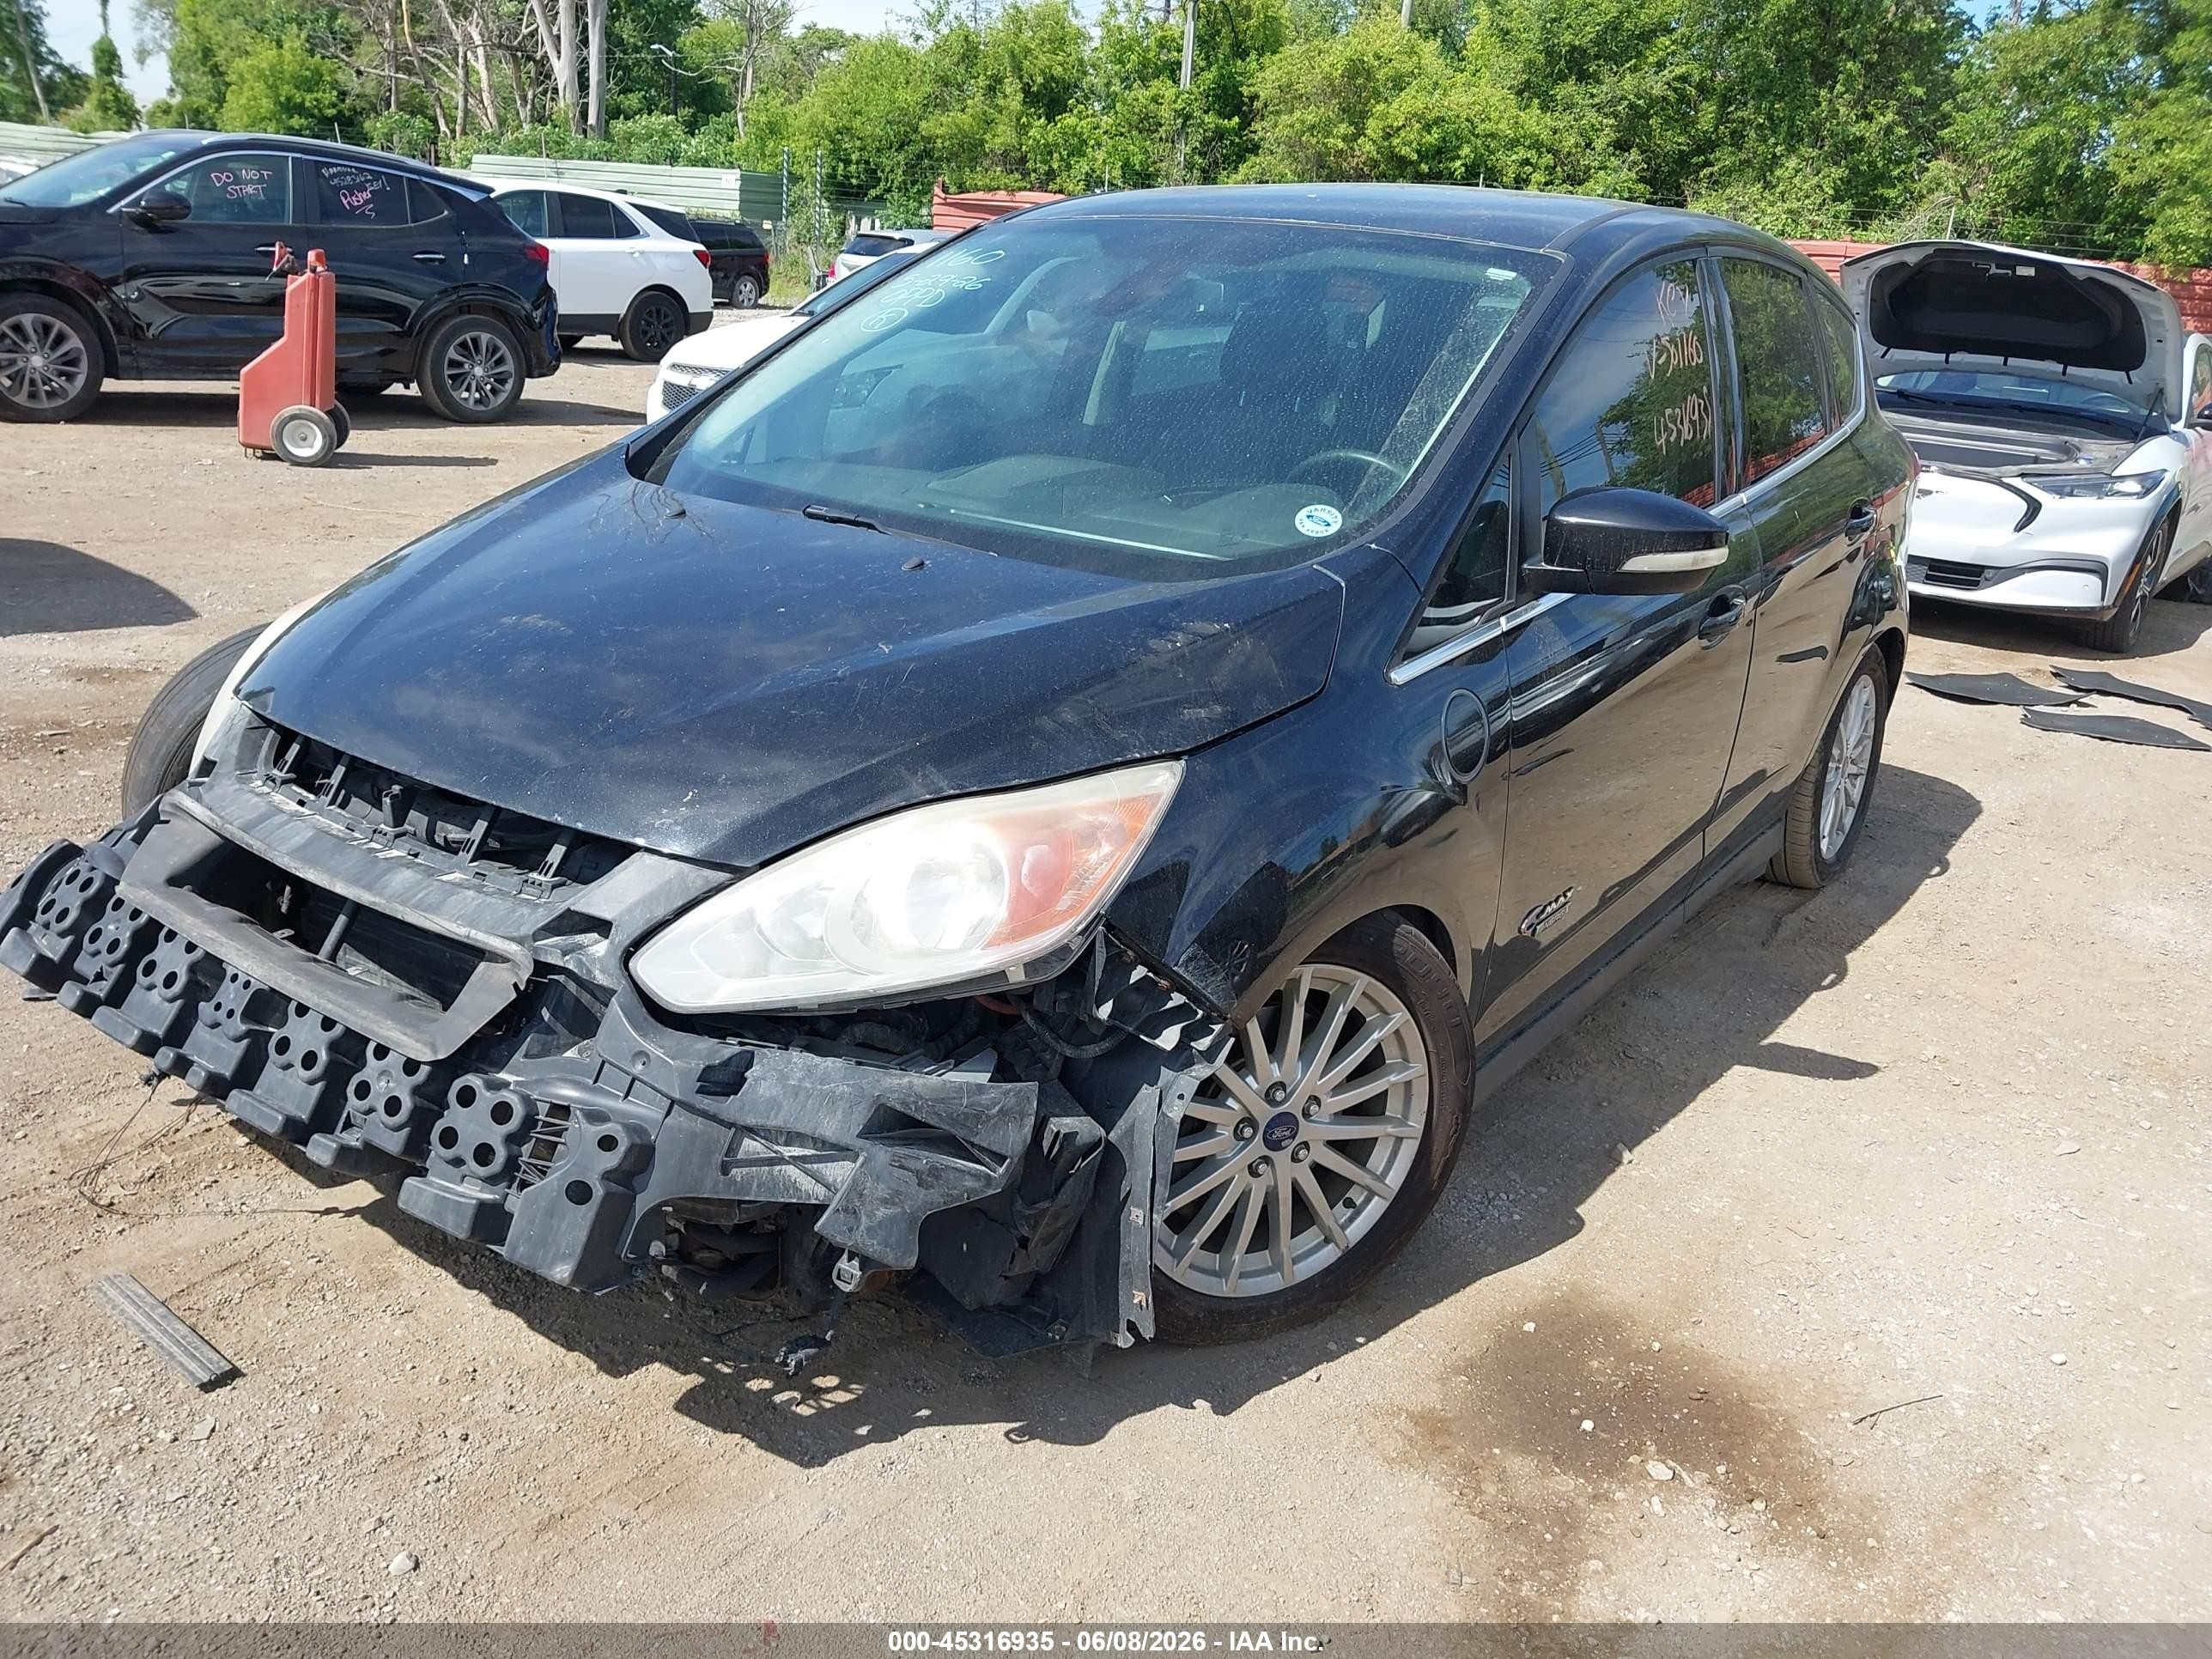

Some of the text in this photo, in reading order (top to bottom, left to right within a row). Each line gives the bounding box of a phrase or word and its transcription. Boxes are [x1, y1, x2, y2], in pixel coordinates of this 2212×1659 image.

[210, 168, 273, 187] DO NOT
[226, 184, 267, 200] START
[926, 248, 1006, 269] 1160
[1654, 385, 1711, 456] 45316935
[1271, 1127, 1292, 1139] Ford
